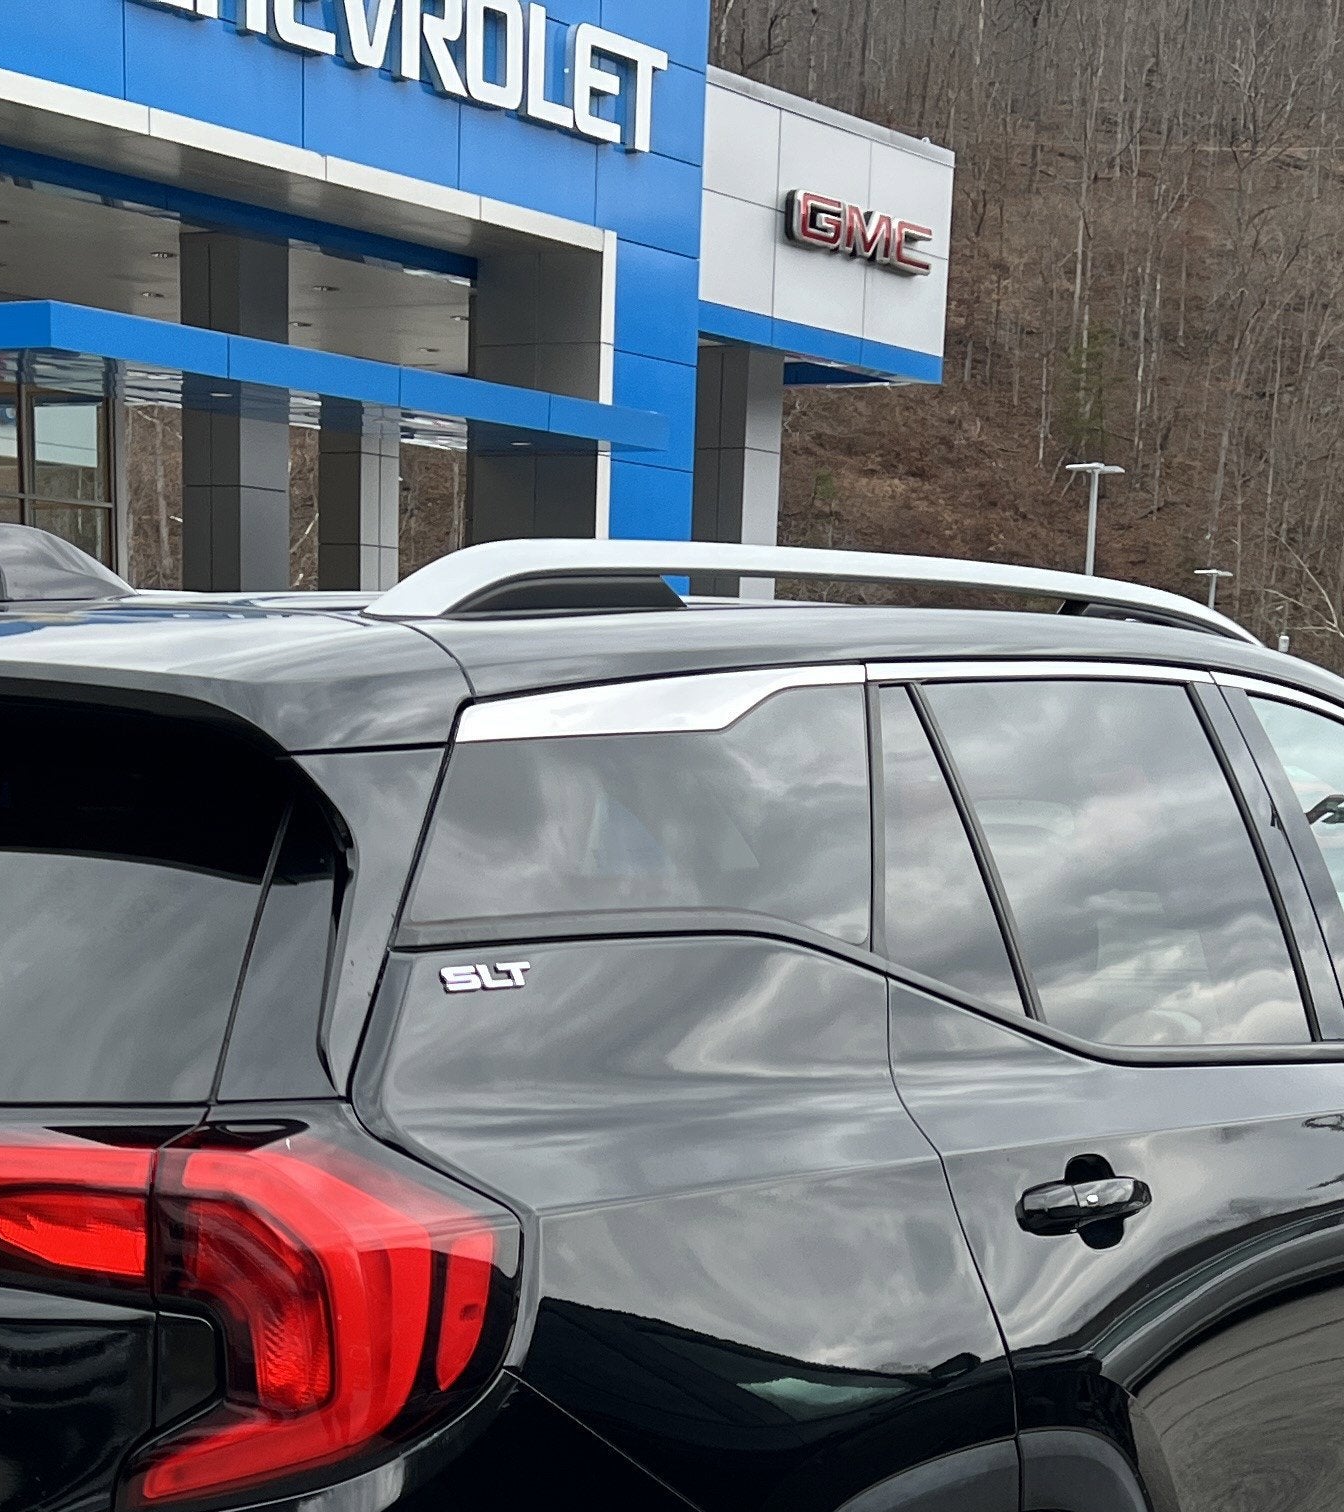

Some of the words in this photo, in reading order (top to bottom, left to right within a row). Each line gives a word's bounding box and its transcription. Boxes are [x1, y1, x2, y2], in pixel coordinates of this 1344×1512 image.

[146, 0, 668, 152] VROLET
[785, 189, 933, 276] GMC
[439, 961, 531, 993] SLT
